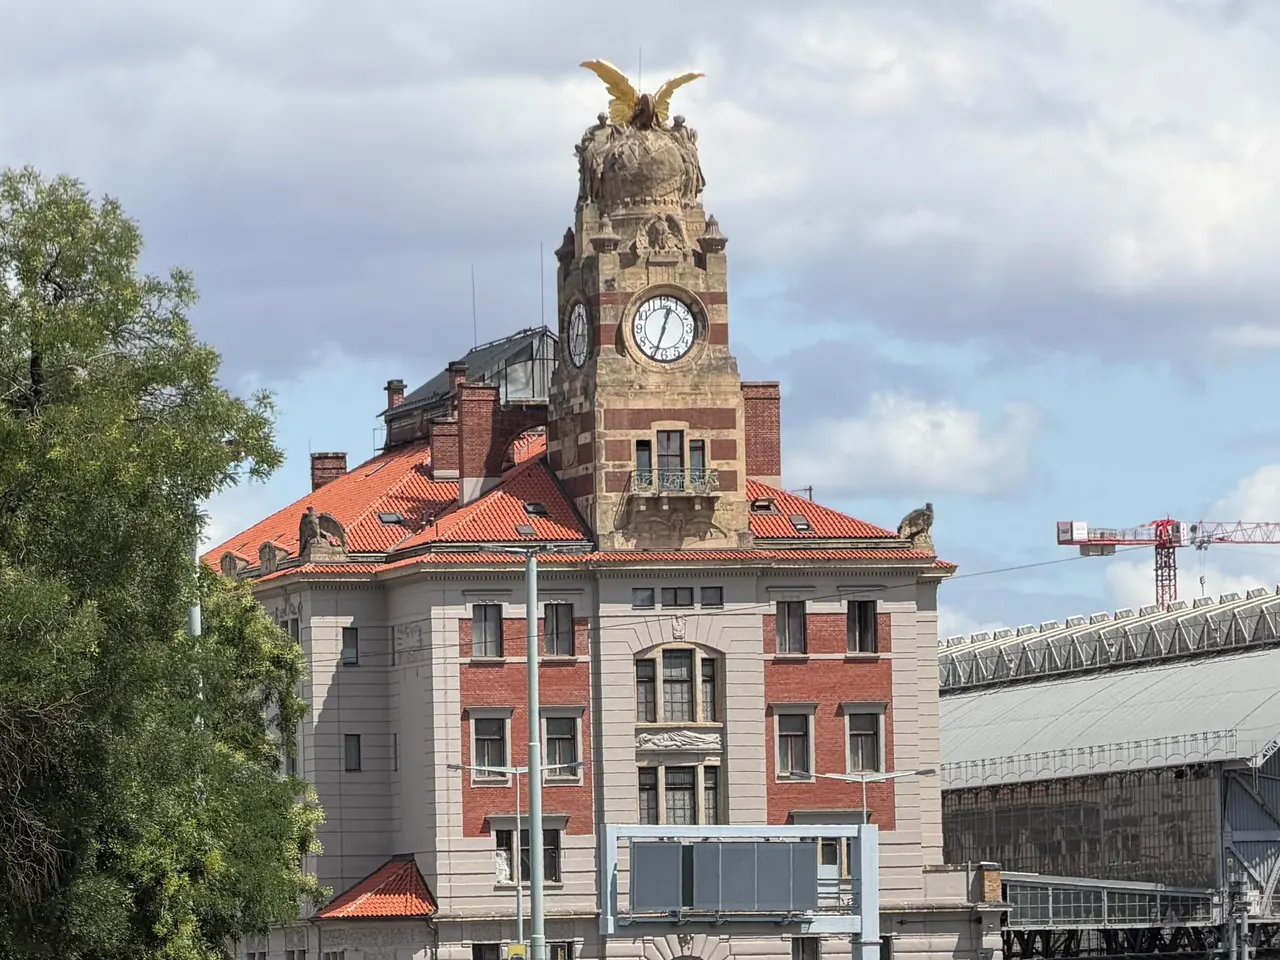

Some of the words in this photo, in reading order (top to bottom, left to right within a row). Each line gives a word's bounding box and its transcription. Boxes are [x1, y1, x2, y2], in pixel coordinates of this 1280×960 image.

[660, 296, 670, 308] 12
[638, 310, 648, 321] 10
[683, 310, 690, 320] 2
[636, 323, 643, 334] 9
[686, 323, 693, 334] 3
[640, 336, 646, 347] 8
[682, 336, 689, 347] 4
[660, 349, 669, 360] 6
[674, 347, 681, 358] 5
